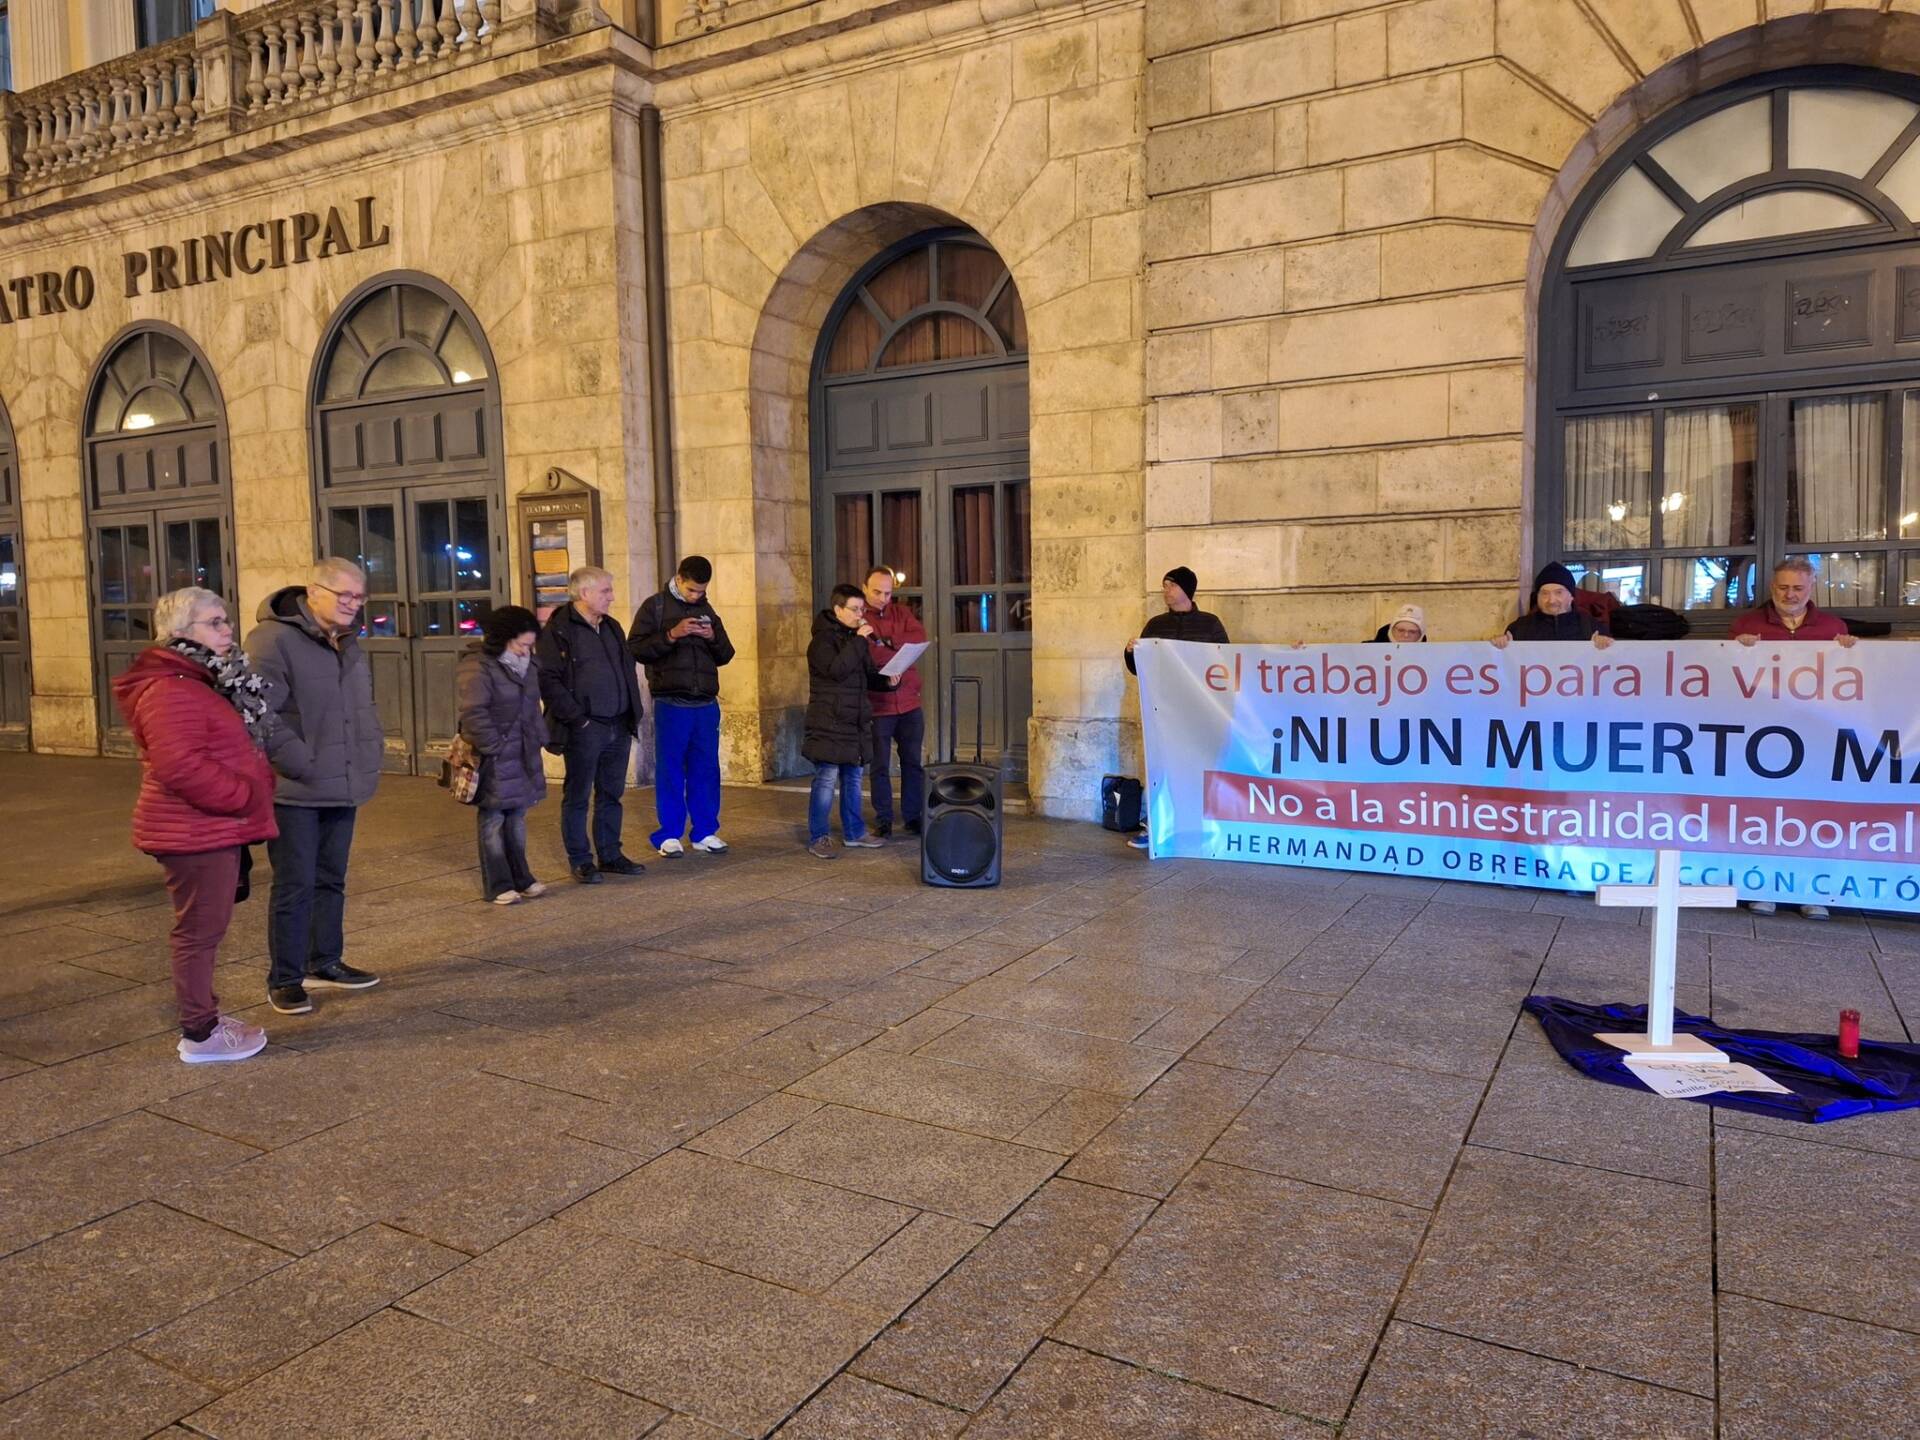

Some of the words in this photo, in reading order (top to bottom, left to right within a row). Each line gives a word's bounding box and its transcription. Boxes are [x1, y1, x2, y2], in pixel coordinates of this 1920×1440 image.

[121, 196, 390, 298] PRINCIPAL
[552, 503, 585, 512] PRINCIP
[1205, 653, 1242, 692] el
[1257, 653, 1428, 706] trabajo
[1445, 663, 1500, 695] es
[1520, 664, 1641, 707] para
[1666, 651, 1710, 697] la
[1732, 652, 1864, 701] vida
[1271, 716, 1347, 774] ¡NI
[1370, 718, 1462, 766] UN
[1486, 720, 1805, 779] MUERTO
[1831, 728, 1920, 784] M
[1248, 782, 1303, 817] No
[1315, 797, 1336, 821] a
[1351, 789, 1384, 824] la
[1399, 791, 1709, 843] siniestralidad
[1729, 804, 1914, 854] laboral
[1227, 833, 1425, 866] HERMANDAD
[1442, 850, 1577, 882] OBRERA
[1591, 861, 1634, 884] DE
[1647, 864, 1796, 894] CCIÓN
[1811, 873, 1920, 902] CATÓ
